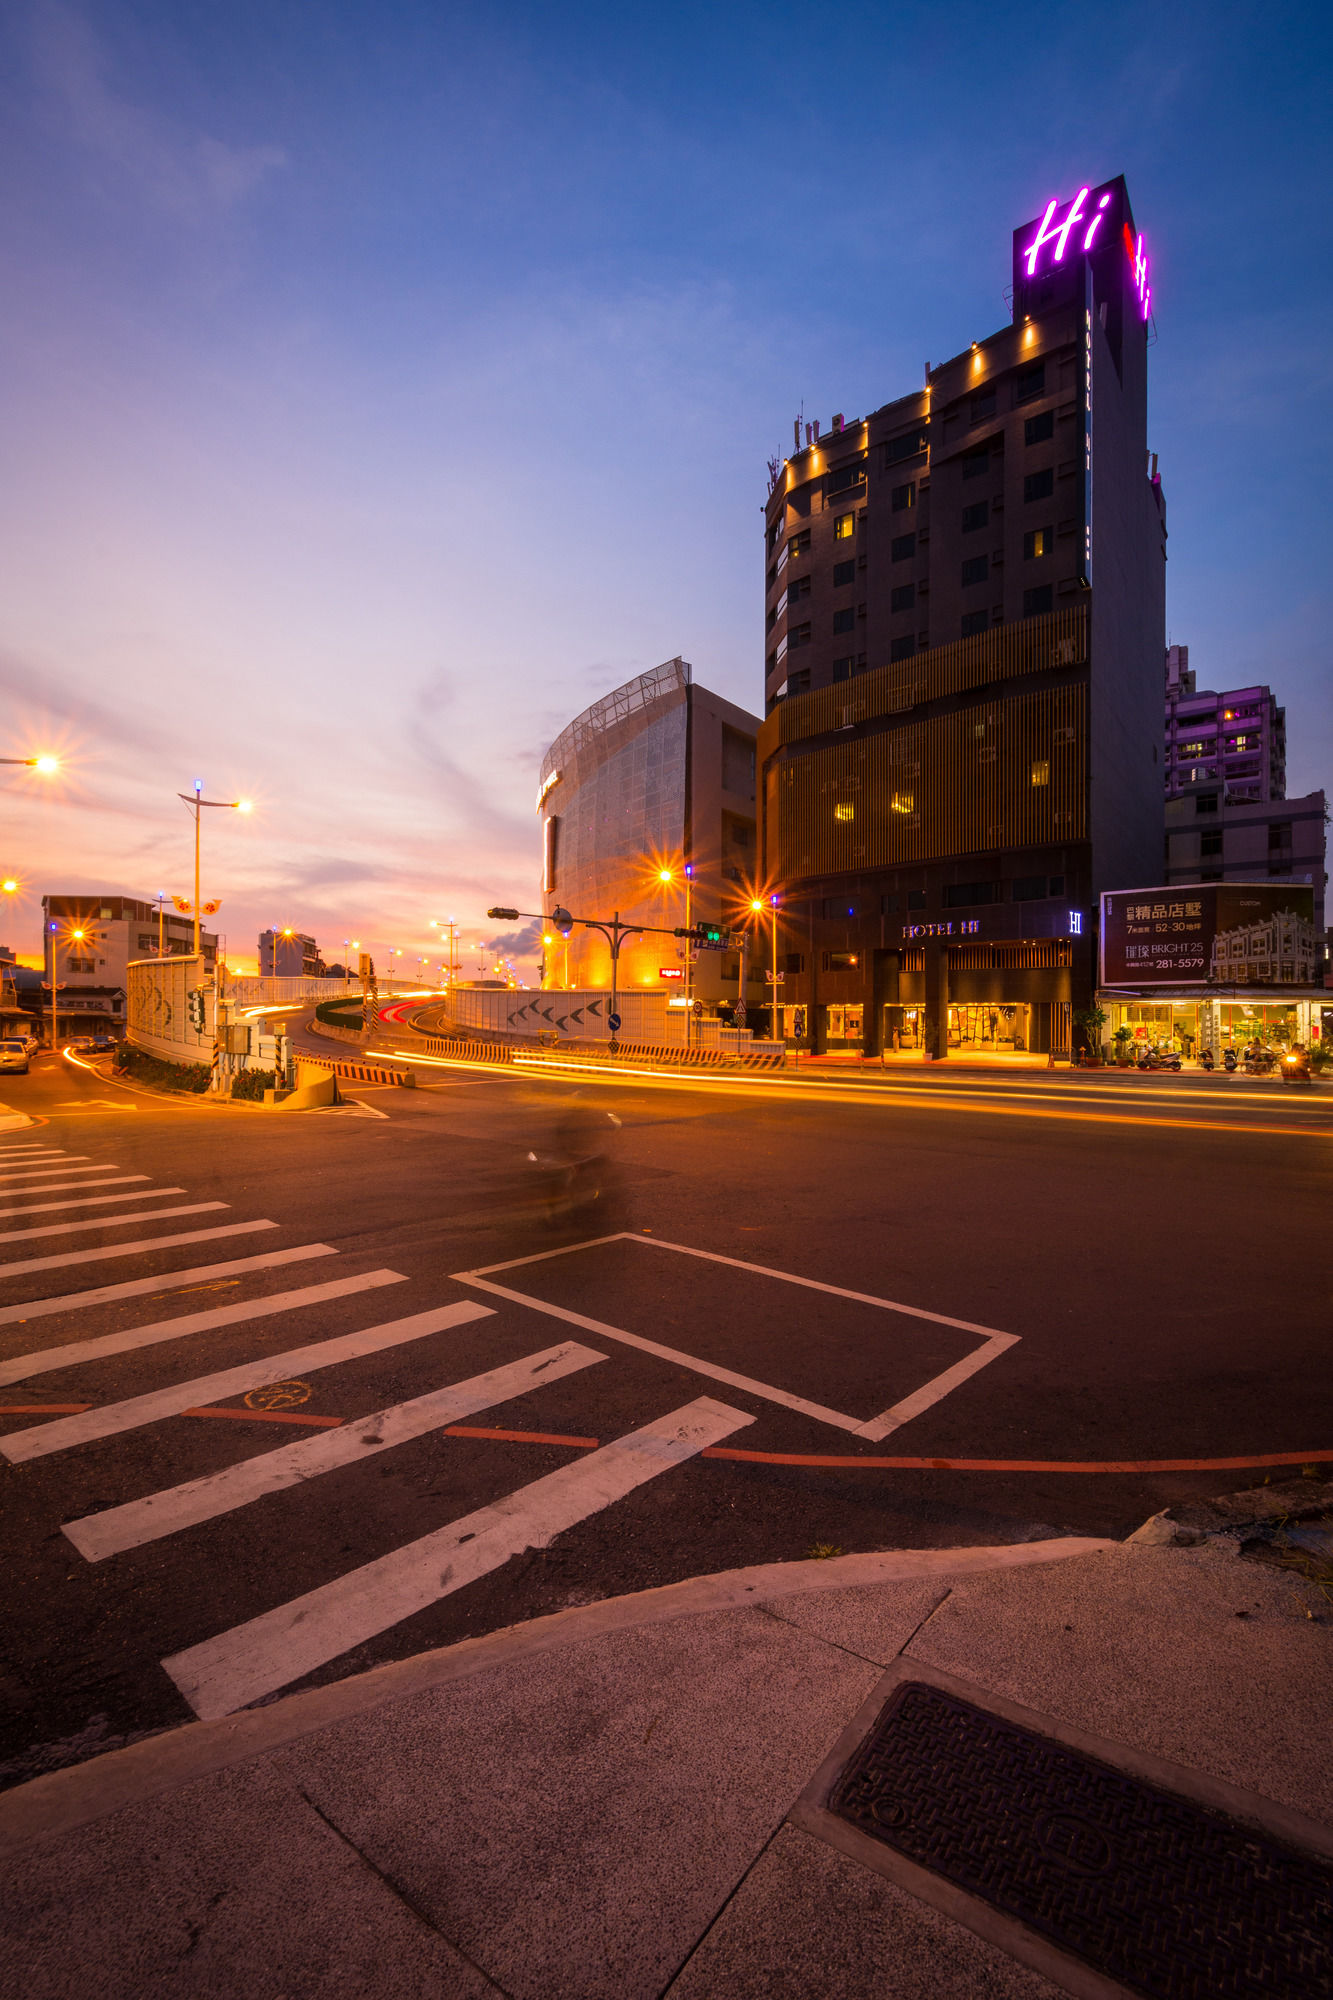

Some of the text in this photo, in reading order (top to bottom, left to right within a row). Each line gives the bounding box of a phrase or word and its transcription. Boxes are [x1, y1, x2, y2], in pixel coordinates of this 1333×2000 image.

[1023, 187, 1111, 276] Hi
[902, 920, 980, 939] HOTEL HI
[1069, 911, 1081, 934] HI
[1151, 944, 1188, 954] BRIGHT
[1190, 942, 1203, 952] 25
[1156, 958, 1204, 968] 281-5579
